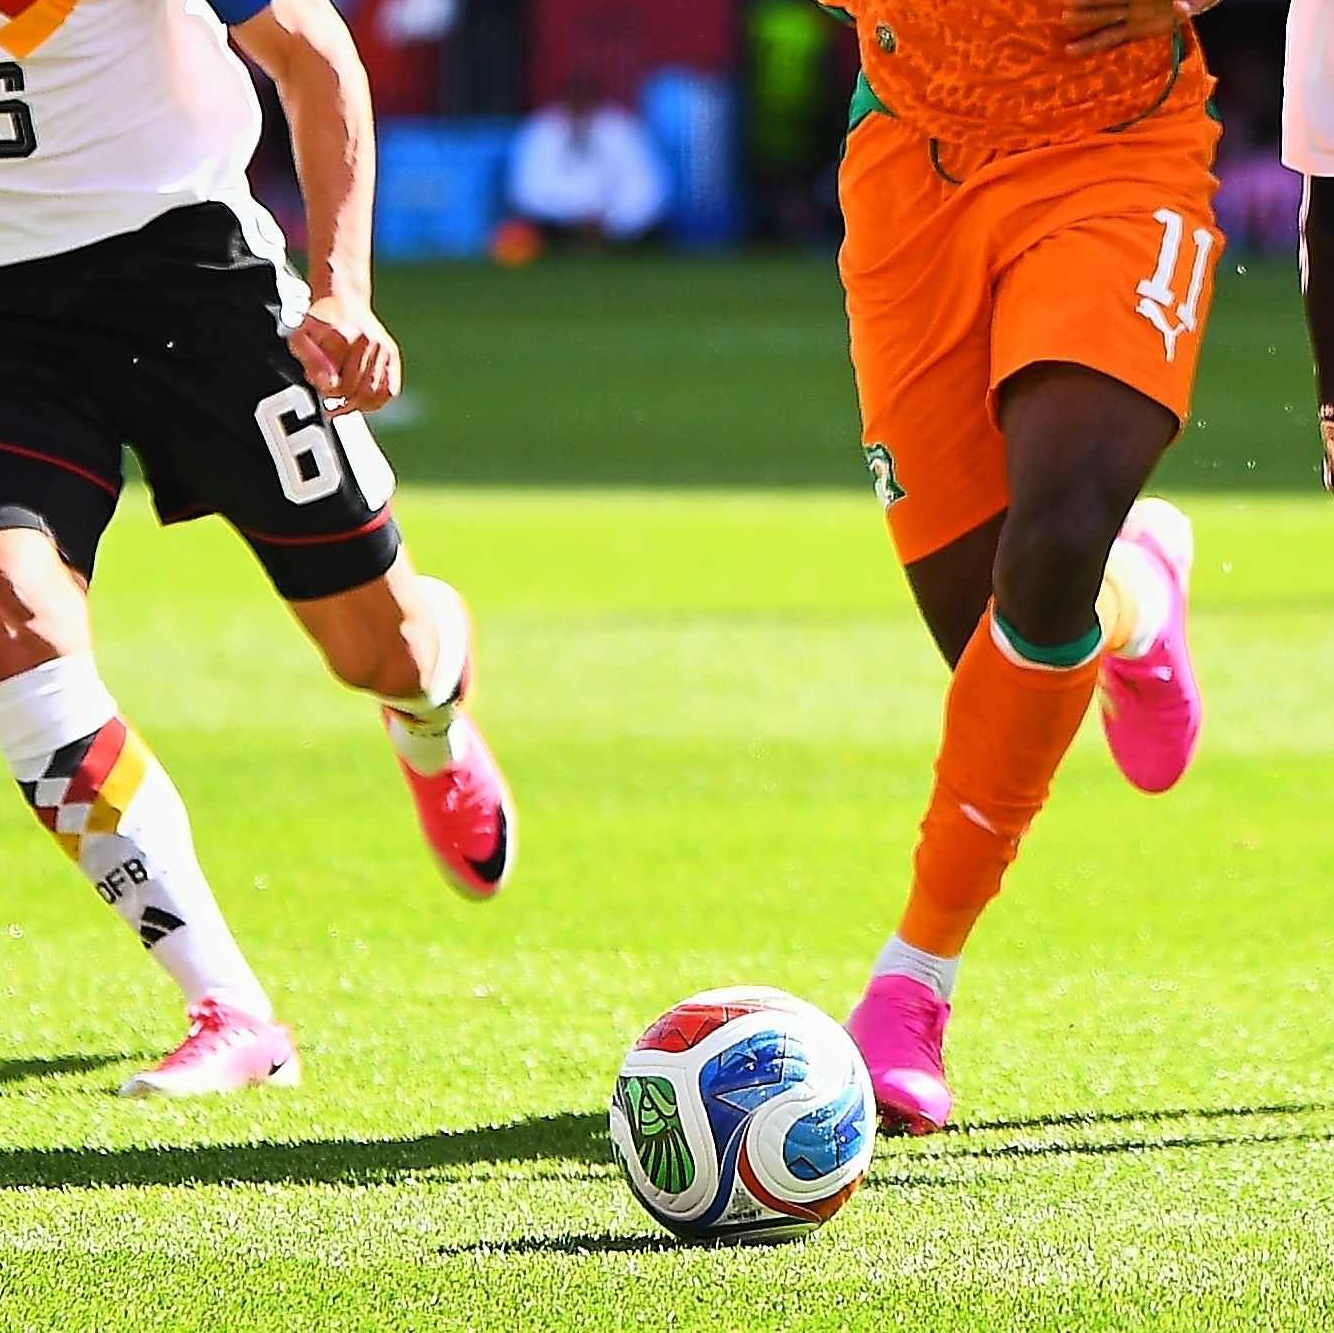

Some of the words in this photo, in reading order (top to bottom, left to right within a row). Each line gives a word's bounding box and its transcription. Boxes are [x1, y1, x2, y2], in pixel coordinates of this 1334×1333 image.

[1135, 208, 1214, 332] 11
[254, 383, 341, 505] 6
[95, 858, 149, 904] DFB
